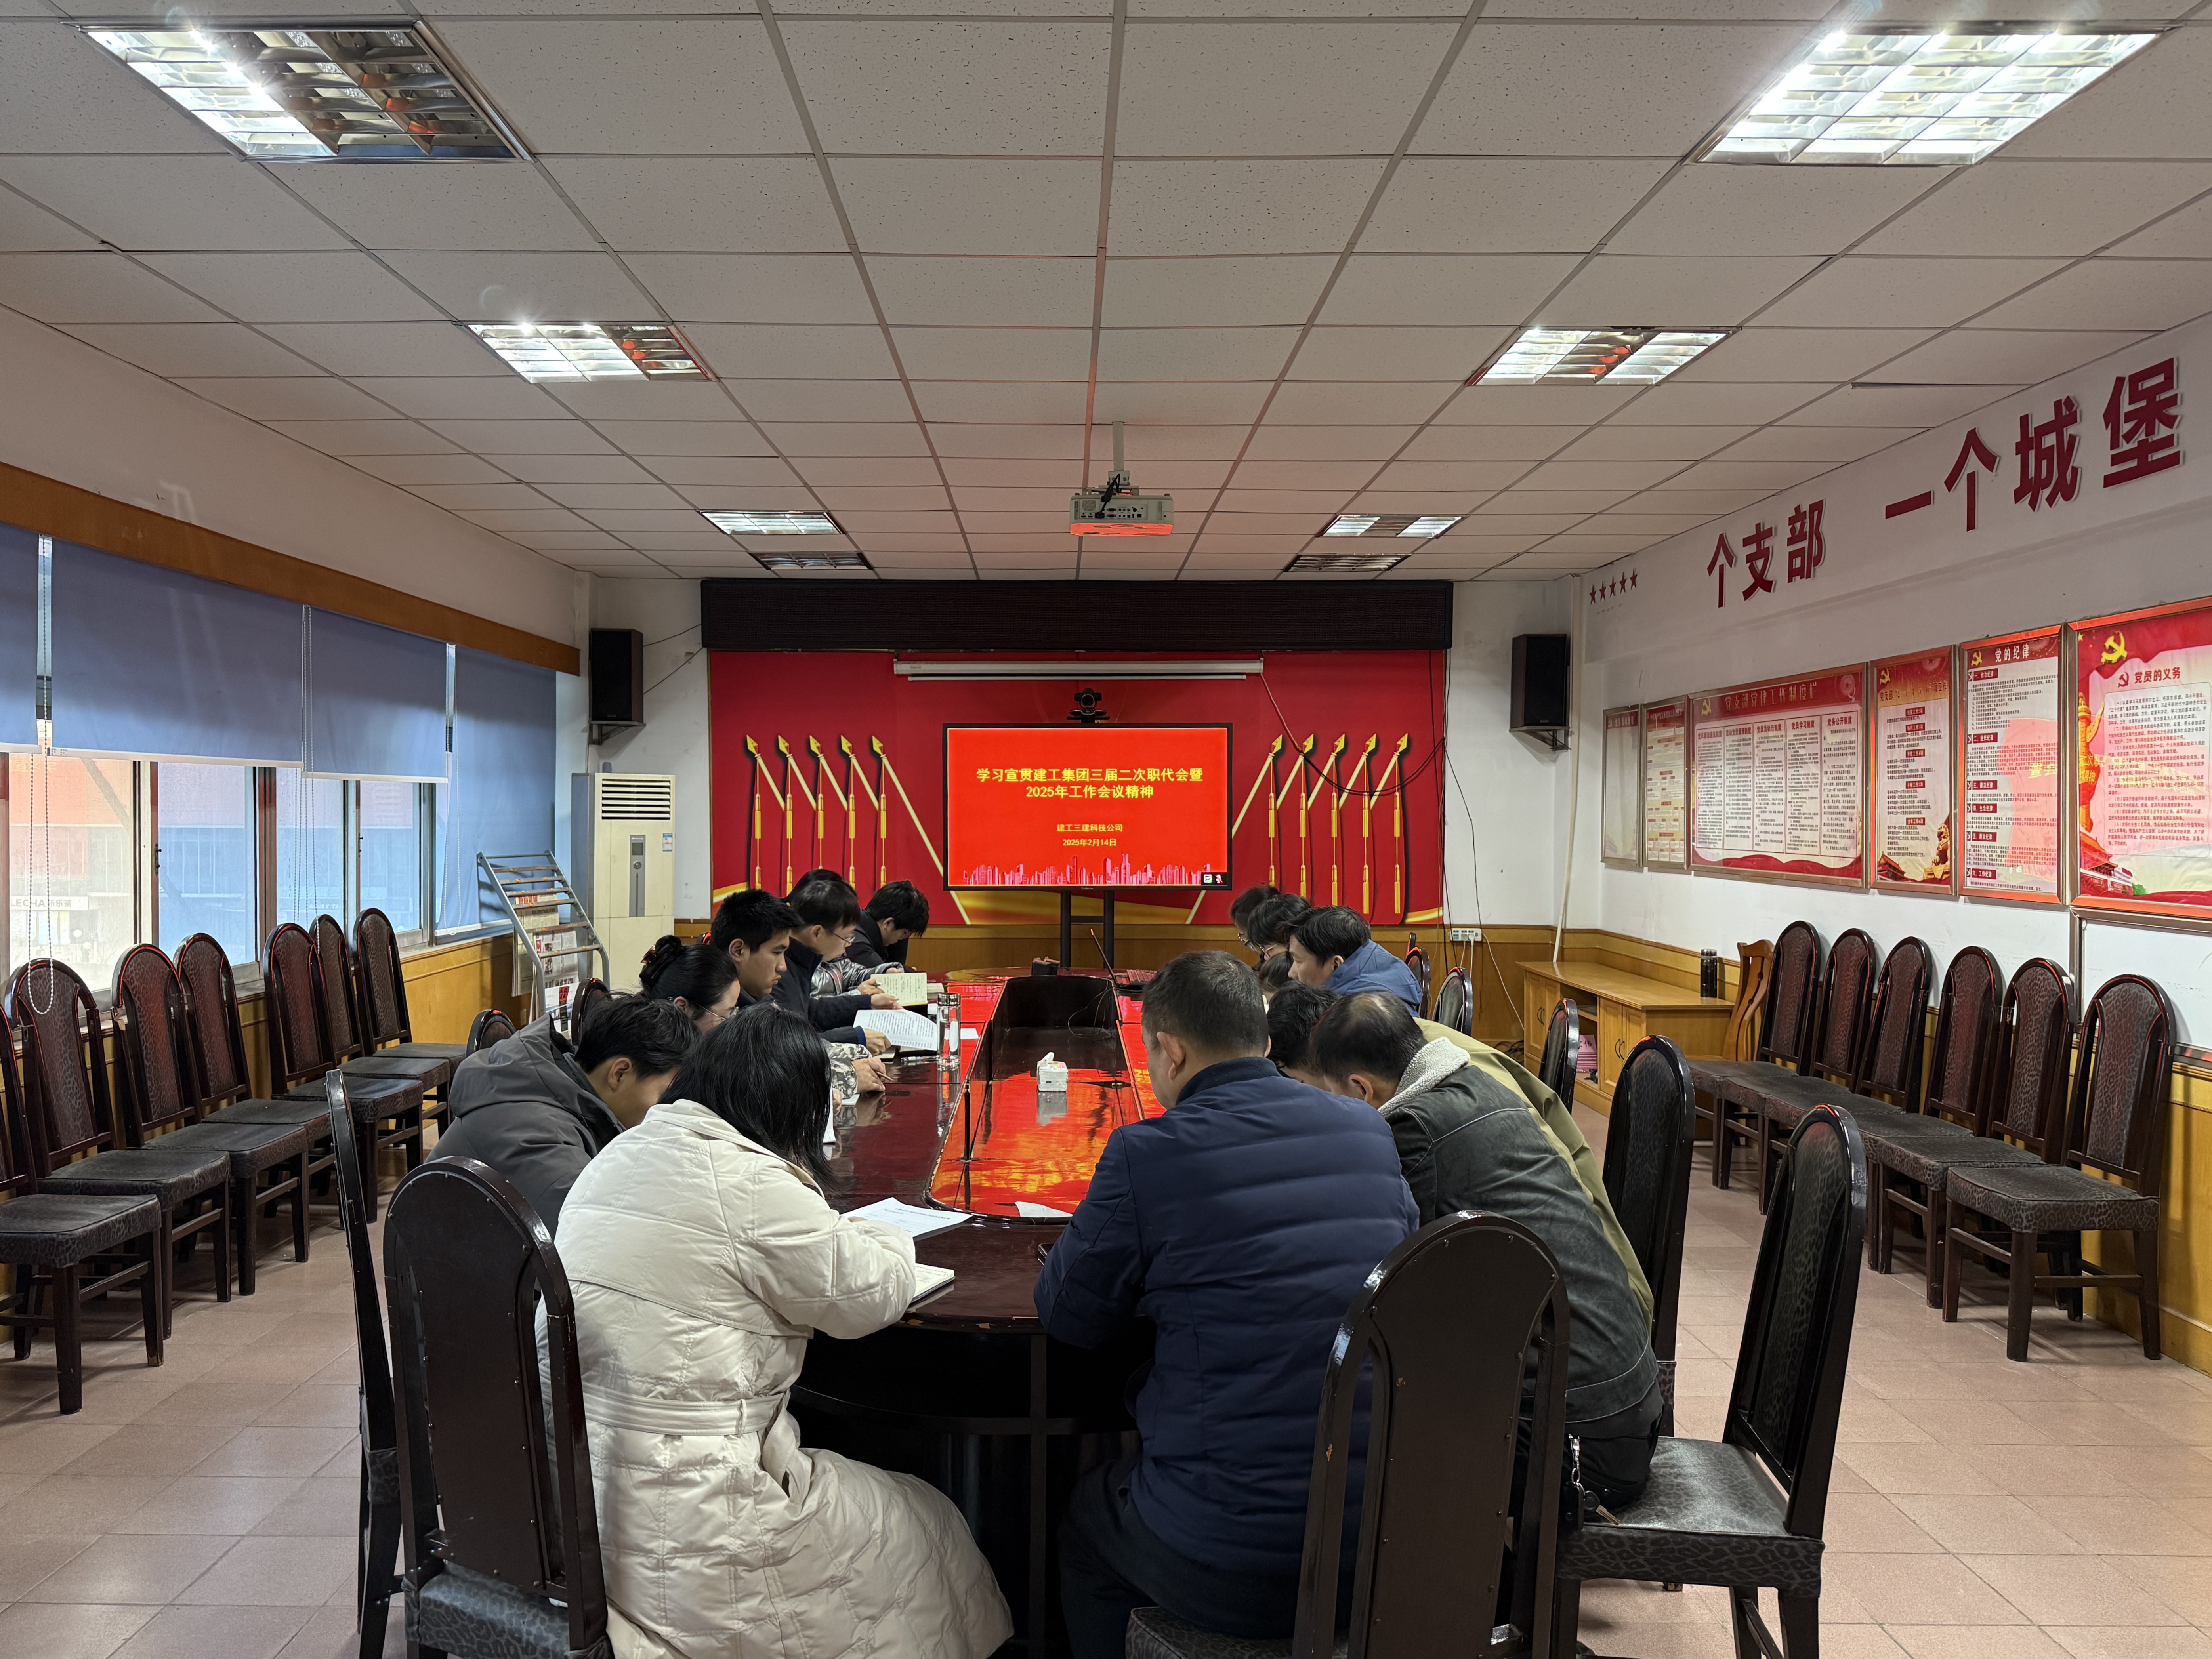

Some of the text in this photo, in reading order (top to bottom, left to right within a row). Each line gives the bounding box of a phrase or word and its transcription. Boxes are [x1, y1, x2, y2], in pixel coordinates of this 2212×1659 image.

[1706, 357, 2182, 608] 个支部 一个城堡
[1995, 643, 2029, 663] 党的纪律
[2134, 667, 2181, 684] 党员的义务
[1791, 720, 1815, 730] 党员学习制度
[1827, 716, 1852, 726] 党务公开制度
[976, 768, 1203, 782] 学习宣贯建工集团三届二次职代会暨
[1025, 785, 1154, 799] 2025年工作会议精神
[1057, 824, 1123, 833] 建工三建科技公司
[1062, 838, 1116, 847] 2025年2月14日
